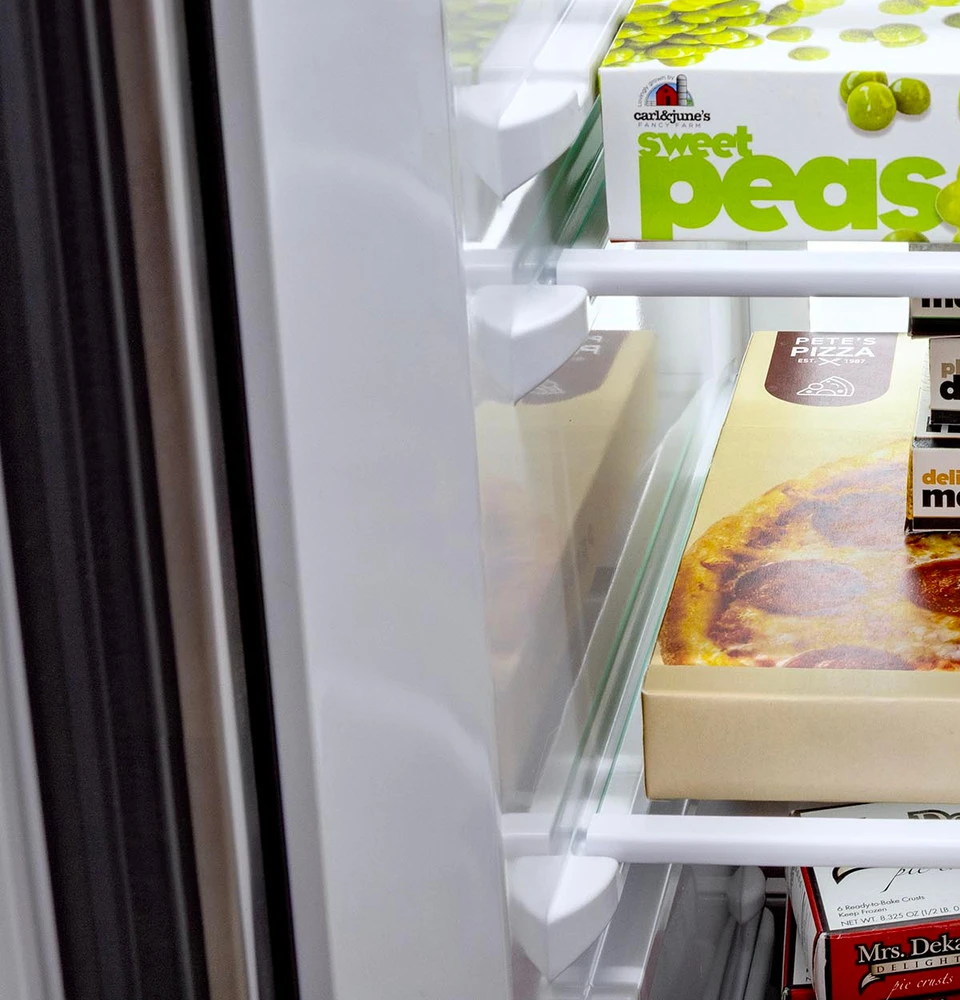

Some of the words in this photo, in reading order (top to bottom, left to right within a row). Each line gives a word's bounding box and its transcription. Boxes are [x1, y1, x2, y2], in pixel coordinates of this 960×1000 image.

[633, 110, 711, 123] carl&june's
[638, 125, 753, 158] sweet
[638, 154, 946, 240] peas
[795, 337, 876, 346] PETE'S
[790, 346, 875, 358] PIZZA
[841, 919, 858, 927] NET
[858, 943, 905, 963] Mrs.
[886, 978, 911, 1000] pie
[916, 973, 954, 988] crusts
